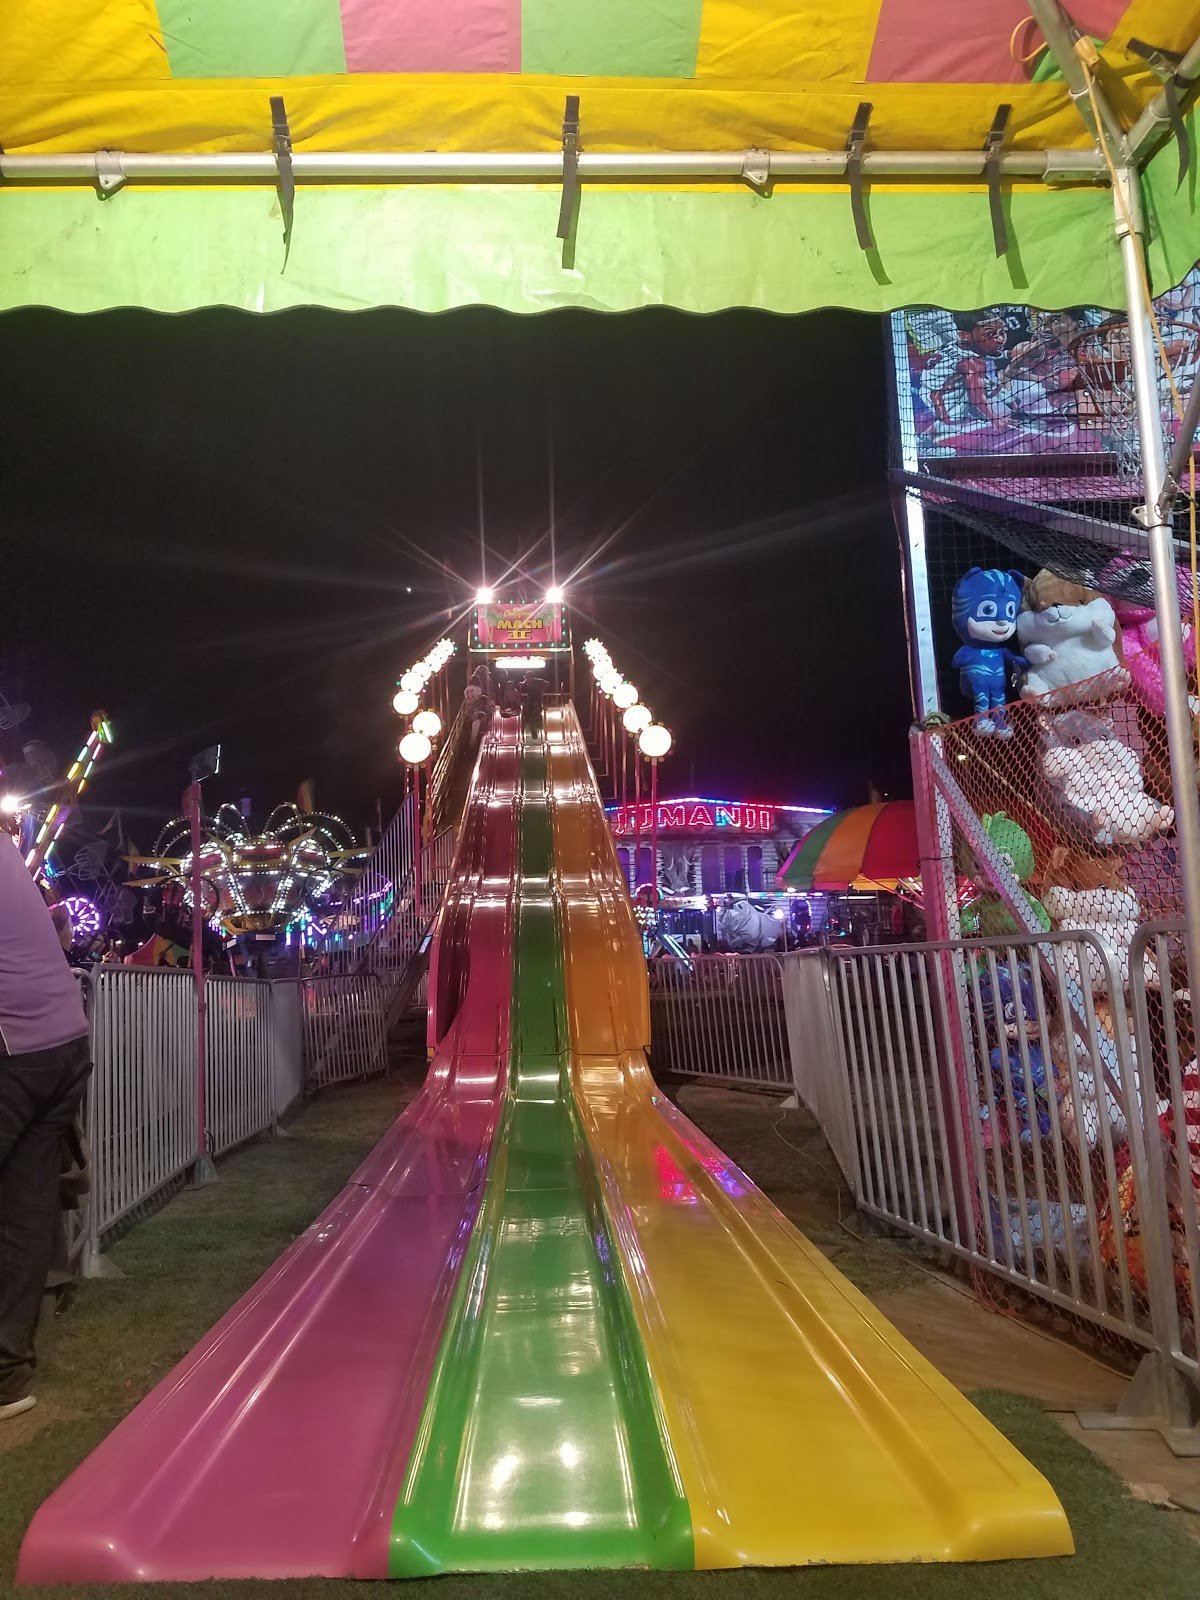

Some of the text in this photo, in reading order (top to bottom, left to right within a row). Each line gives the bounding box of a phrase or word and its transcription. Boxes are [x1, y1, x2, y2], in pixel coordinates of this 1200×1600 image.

[496, 620, 543, 629] MACH
[507, 630, 532, 640] II
[615, 805, 770, 834] JUMANJI
